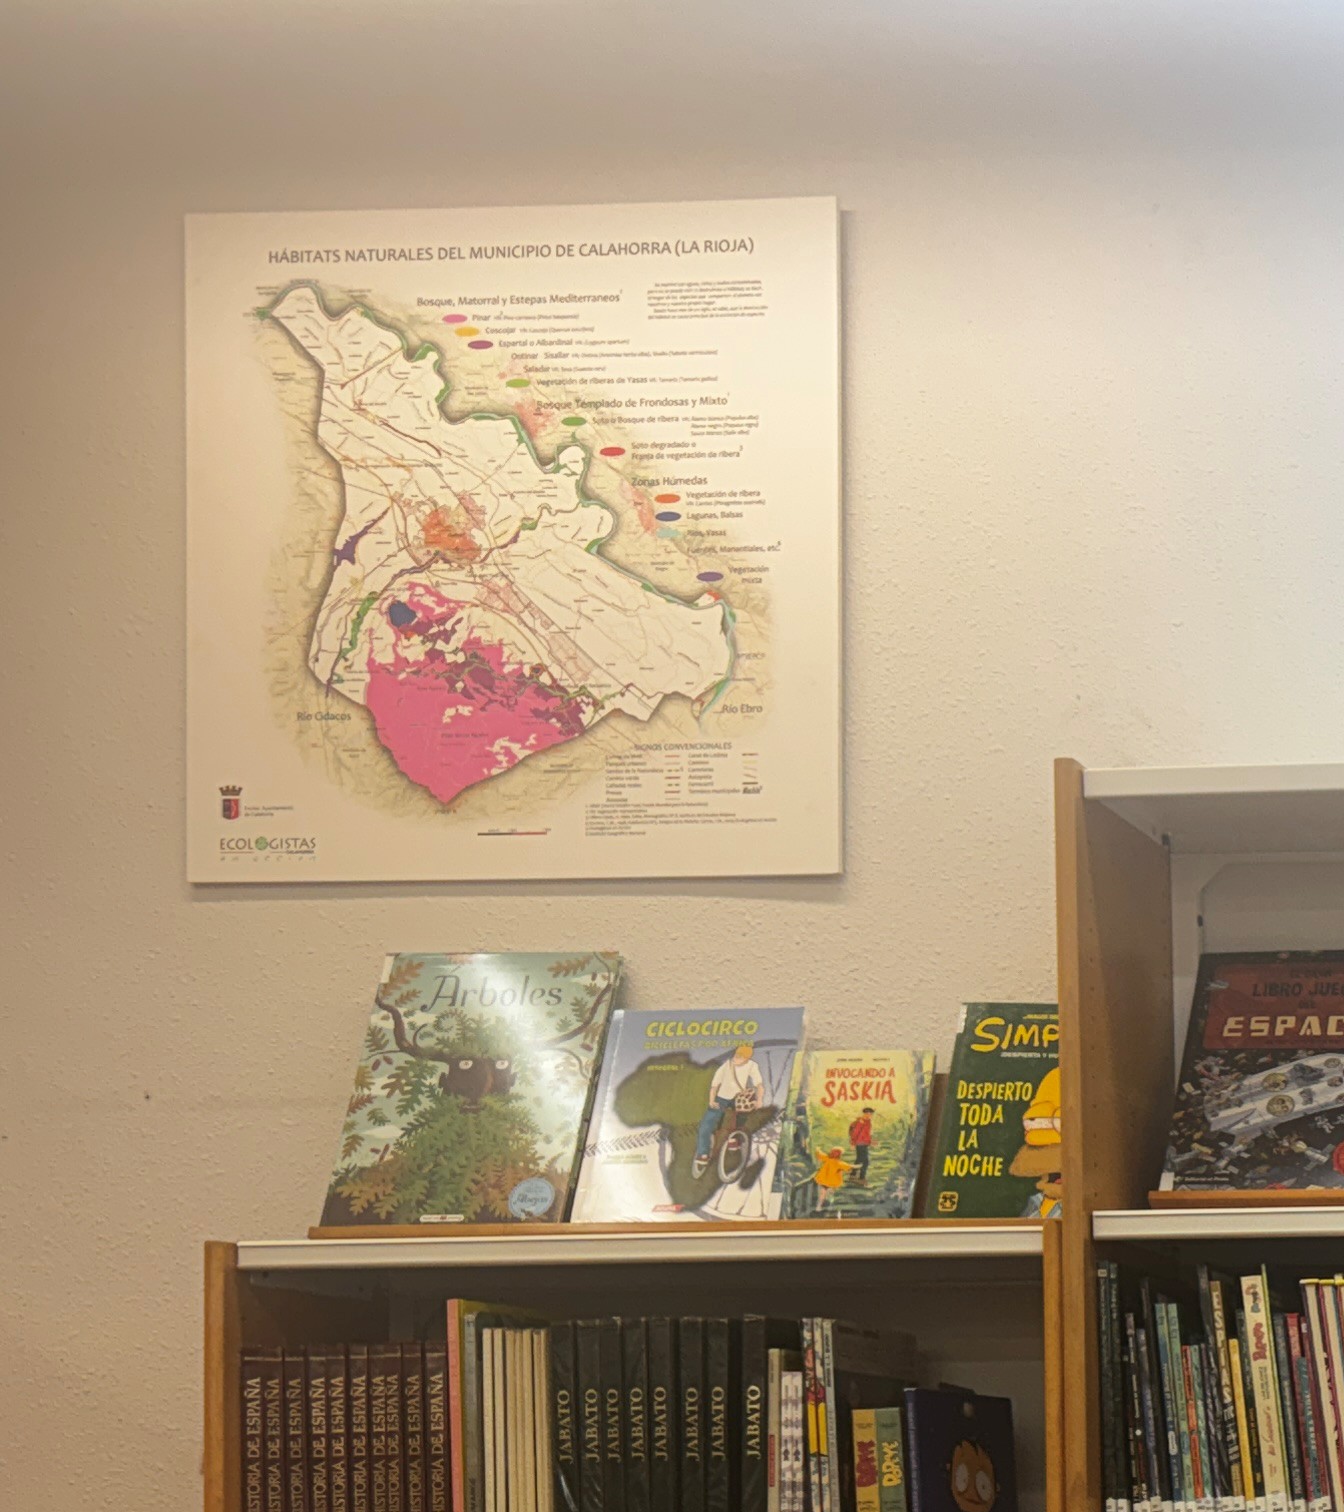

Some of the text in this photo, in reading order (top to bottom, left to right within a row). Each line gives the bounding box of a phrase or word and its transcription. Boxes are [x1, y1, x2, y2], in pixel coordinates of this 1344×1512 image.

[268, 237, 755, 263] HÁBITATS NATURALES DEL MUNICIPIO DE CALAHORRA (LA RIOJA)
[457, 295, 500, 306] Matorral
[509, 294, 547, 306] Estepas
[420, 965, 563, 1012] Árboles
[1252, 981, 1302, 998] LIBRO
[645, 1020, 759, 1038] CICLOCIRCO
[825, 1067, 896, 1080] INVOCANDO A
[821, 1079, 897, 1108] SASKIA
[956, 1079, 1033, 1100] DESPIERTO
[959, 1102, 1004, 1126] TODA
[957, 1128, 979, 1152] LA
[942, 1154, 1004, 1178] NOCHE
[557, 1389, 575, 1463] JABATO
[585, 1388, 601, 1463] JABATO
[631, 1387, 646, 1461] JABATO
[711, 1386, 726, 1461] JABATO
[747, 1385, 762, 1459] JABATO
[247, 1440, 261, 1458] DE
[312, 1438, 327, 1457] DE
[354, 1437, 367, 1456] DE
[430, 1434, 444, 1453] DE
